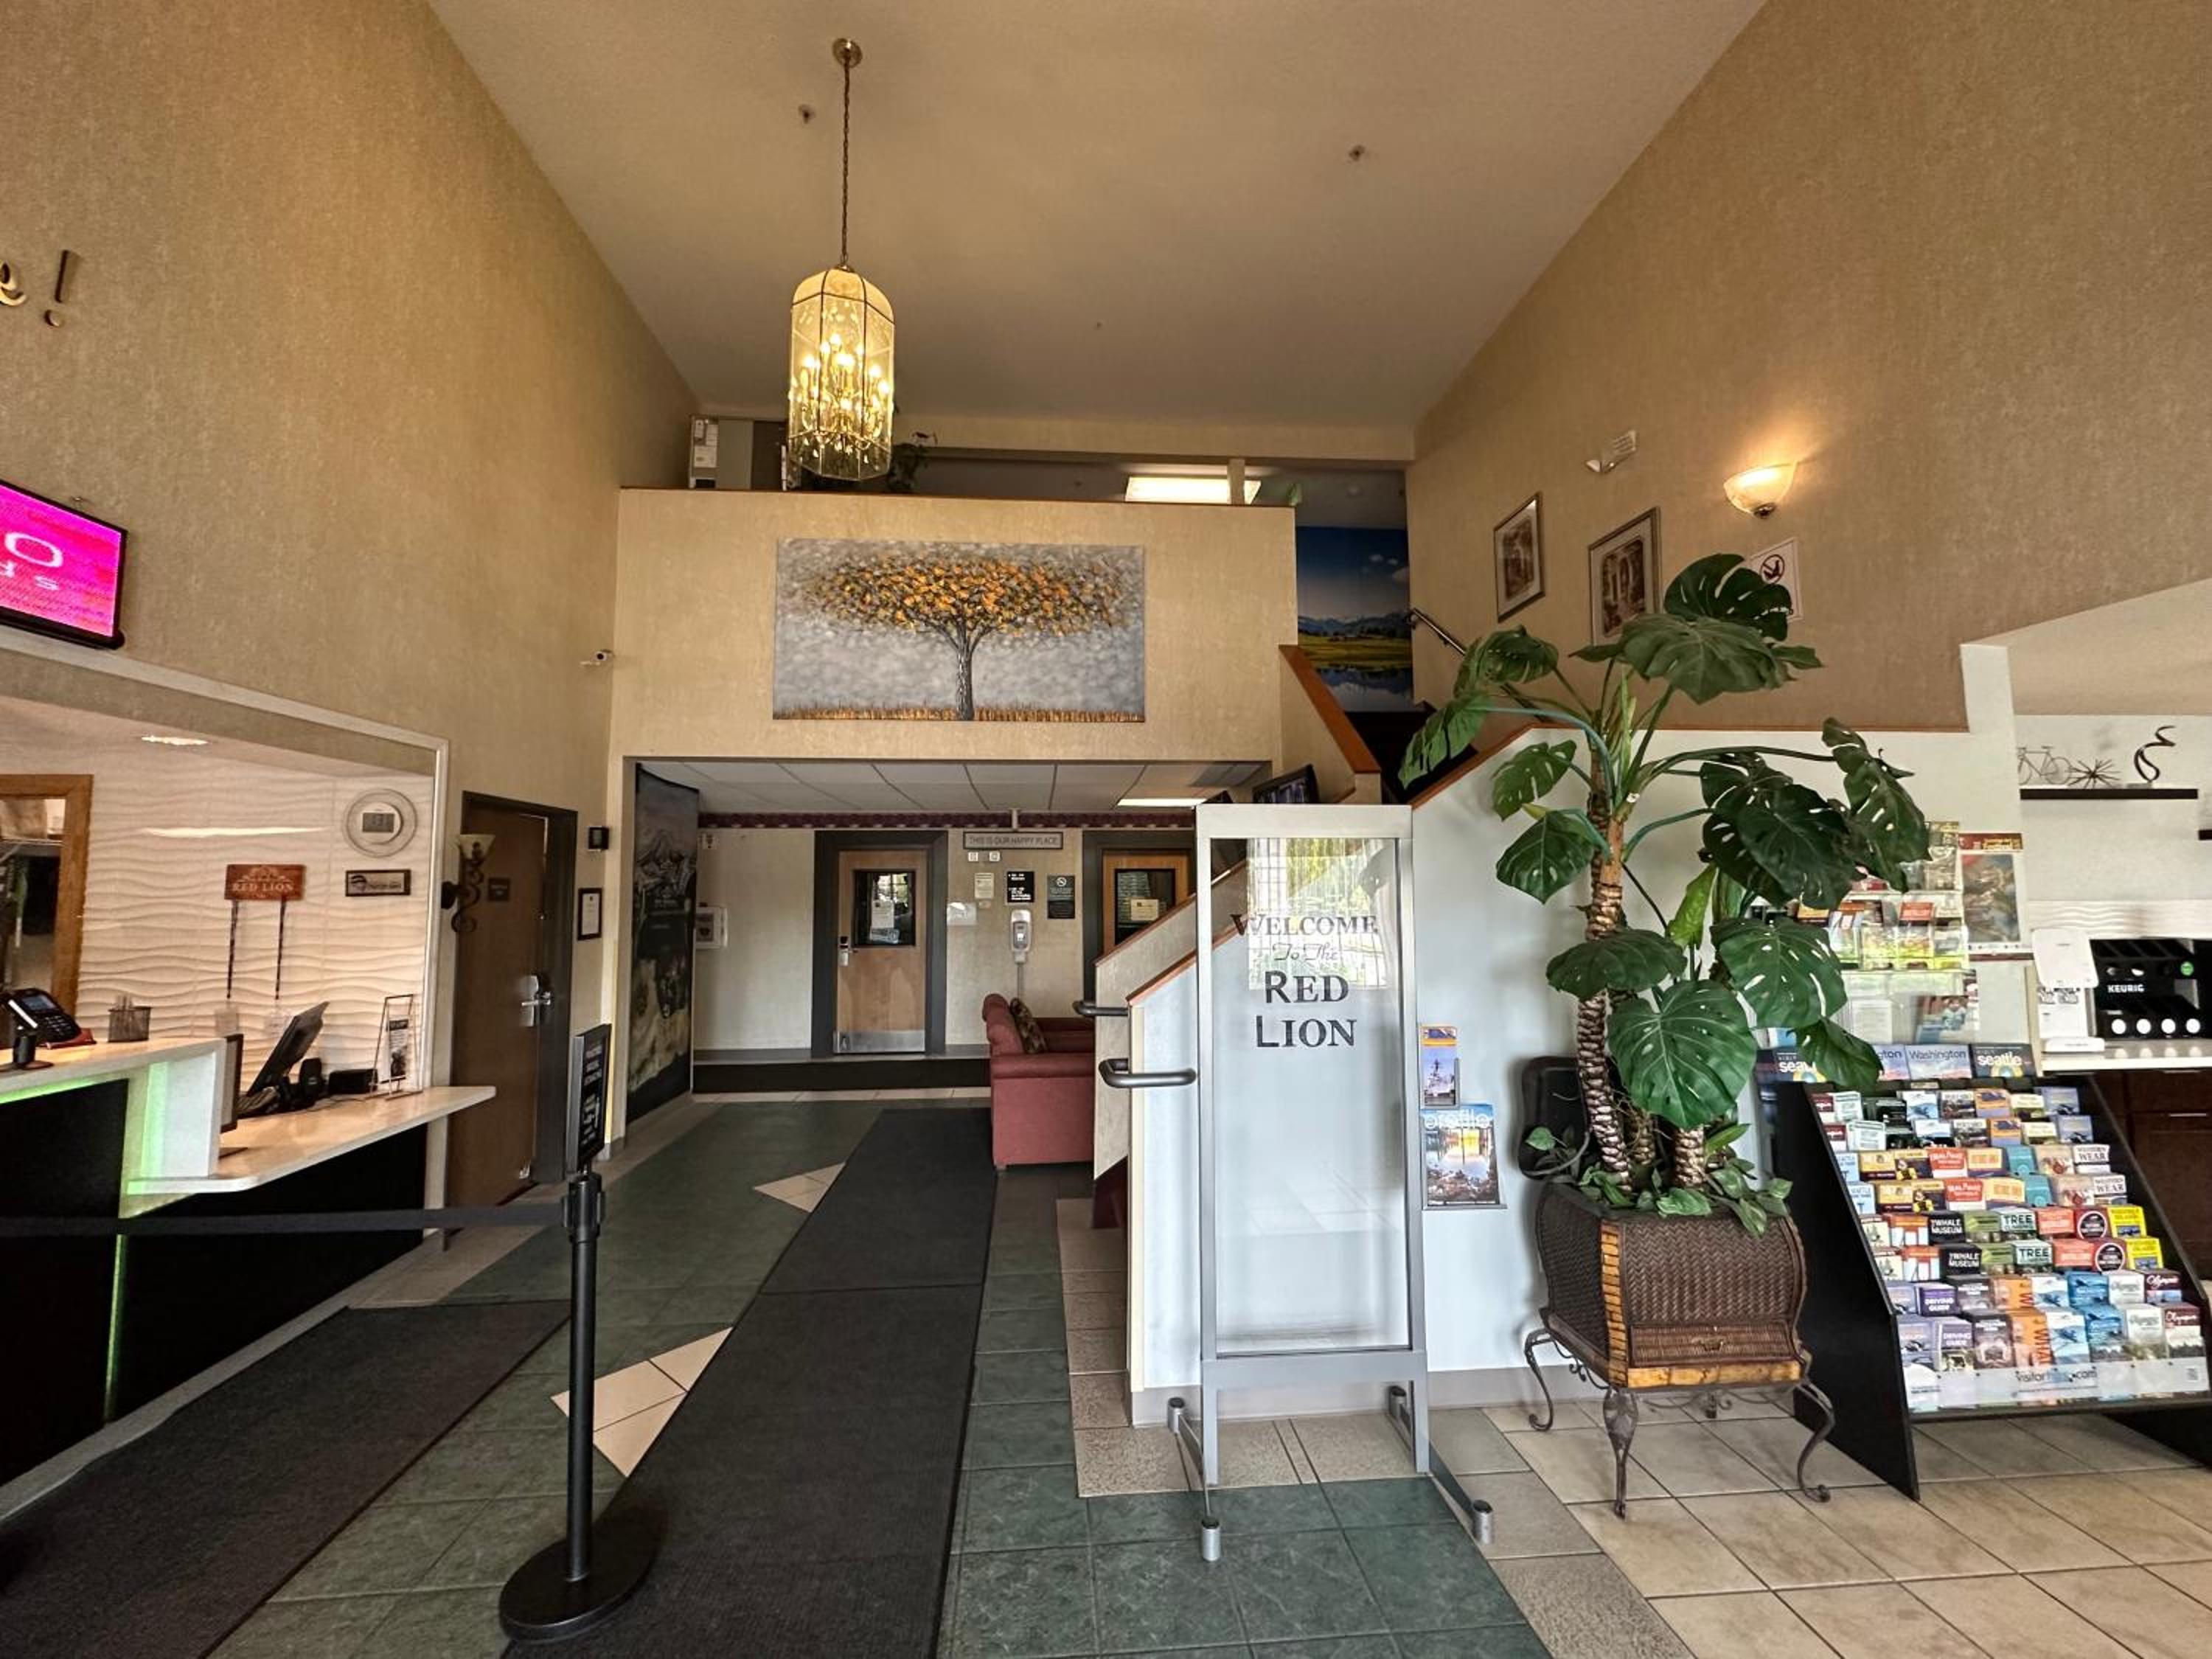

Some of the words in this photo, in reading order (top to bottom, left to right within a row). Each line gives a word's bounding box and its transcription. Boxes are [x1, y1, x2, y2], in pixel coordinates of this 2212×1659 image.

[232, 883, 257, 891] RED
[262, 883, 293, 891] LION
[1230, 914, 1379, 936] WELCOME
[1272, 942, 1299, 961] To
[1303, 942, 1338, 961] The
[1265, 970, 1349, 1004] RED
[2107, 984, 2145, 993] KEURIG
[1256, 1015, 1357, 1048] LION
[1909, 1050, 1966, 1061] Washington
[1978, 1051, 2023, 1067] seattle
[2079, 1152, 2107, 1161] WEAR
[2096, 1184, 2124, 1192] WEAR
[2003, 1214, 2032, 1224] TREE
[2019, 1249, 2049, 1257] TREE
[1943, 1332, 1972, 1340] DRIVING
